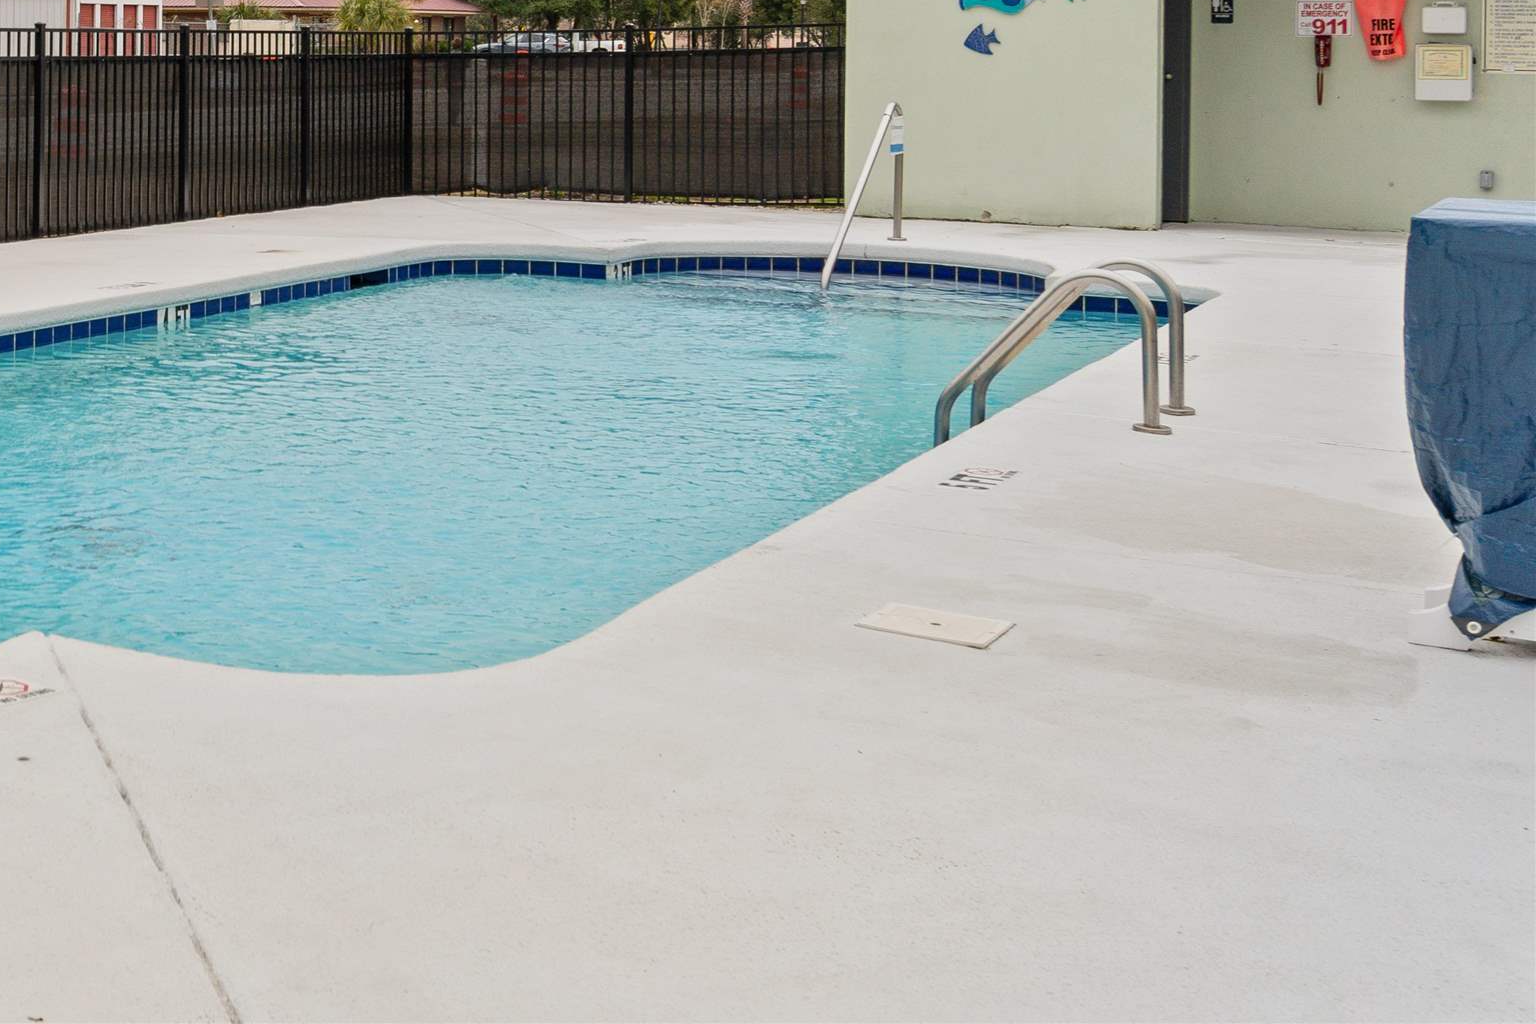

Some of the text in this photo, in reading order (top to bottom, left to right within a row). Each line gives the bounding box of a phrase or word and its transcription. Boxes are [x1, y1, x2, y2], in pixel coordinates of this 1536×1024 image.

[1335, 2, 1345, 10] OF
[1312, 19, 1347, 34] 911
[1371, 18, 1396, 31] FIRE
